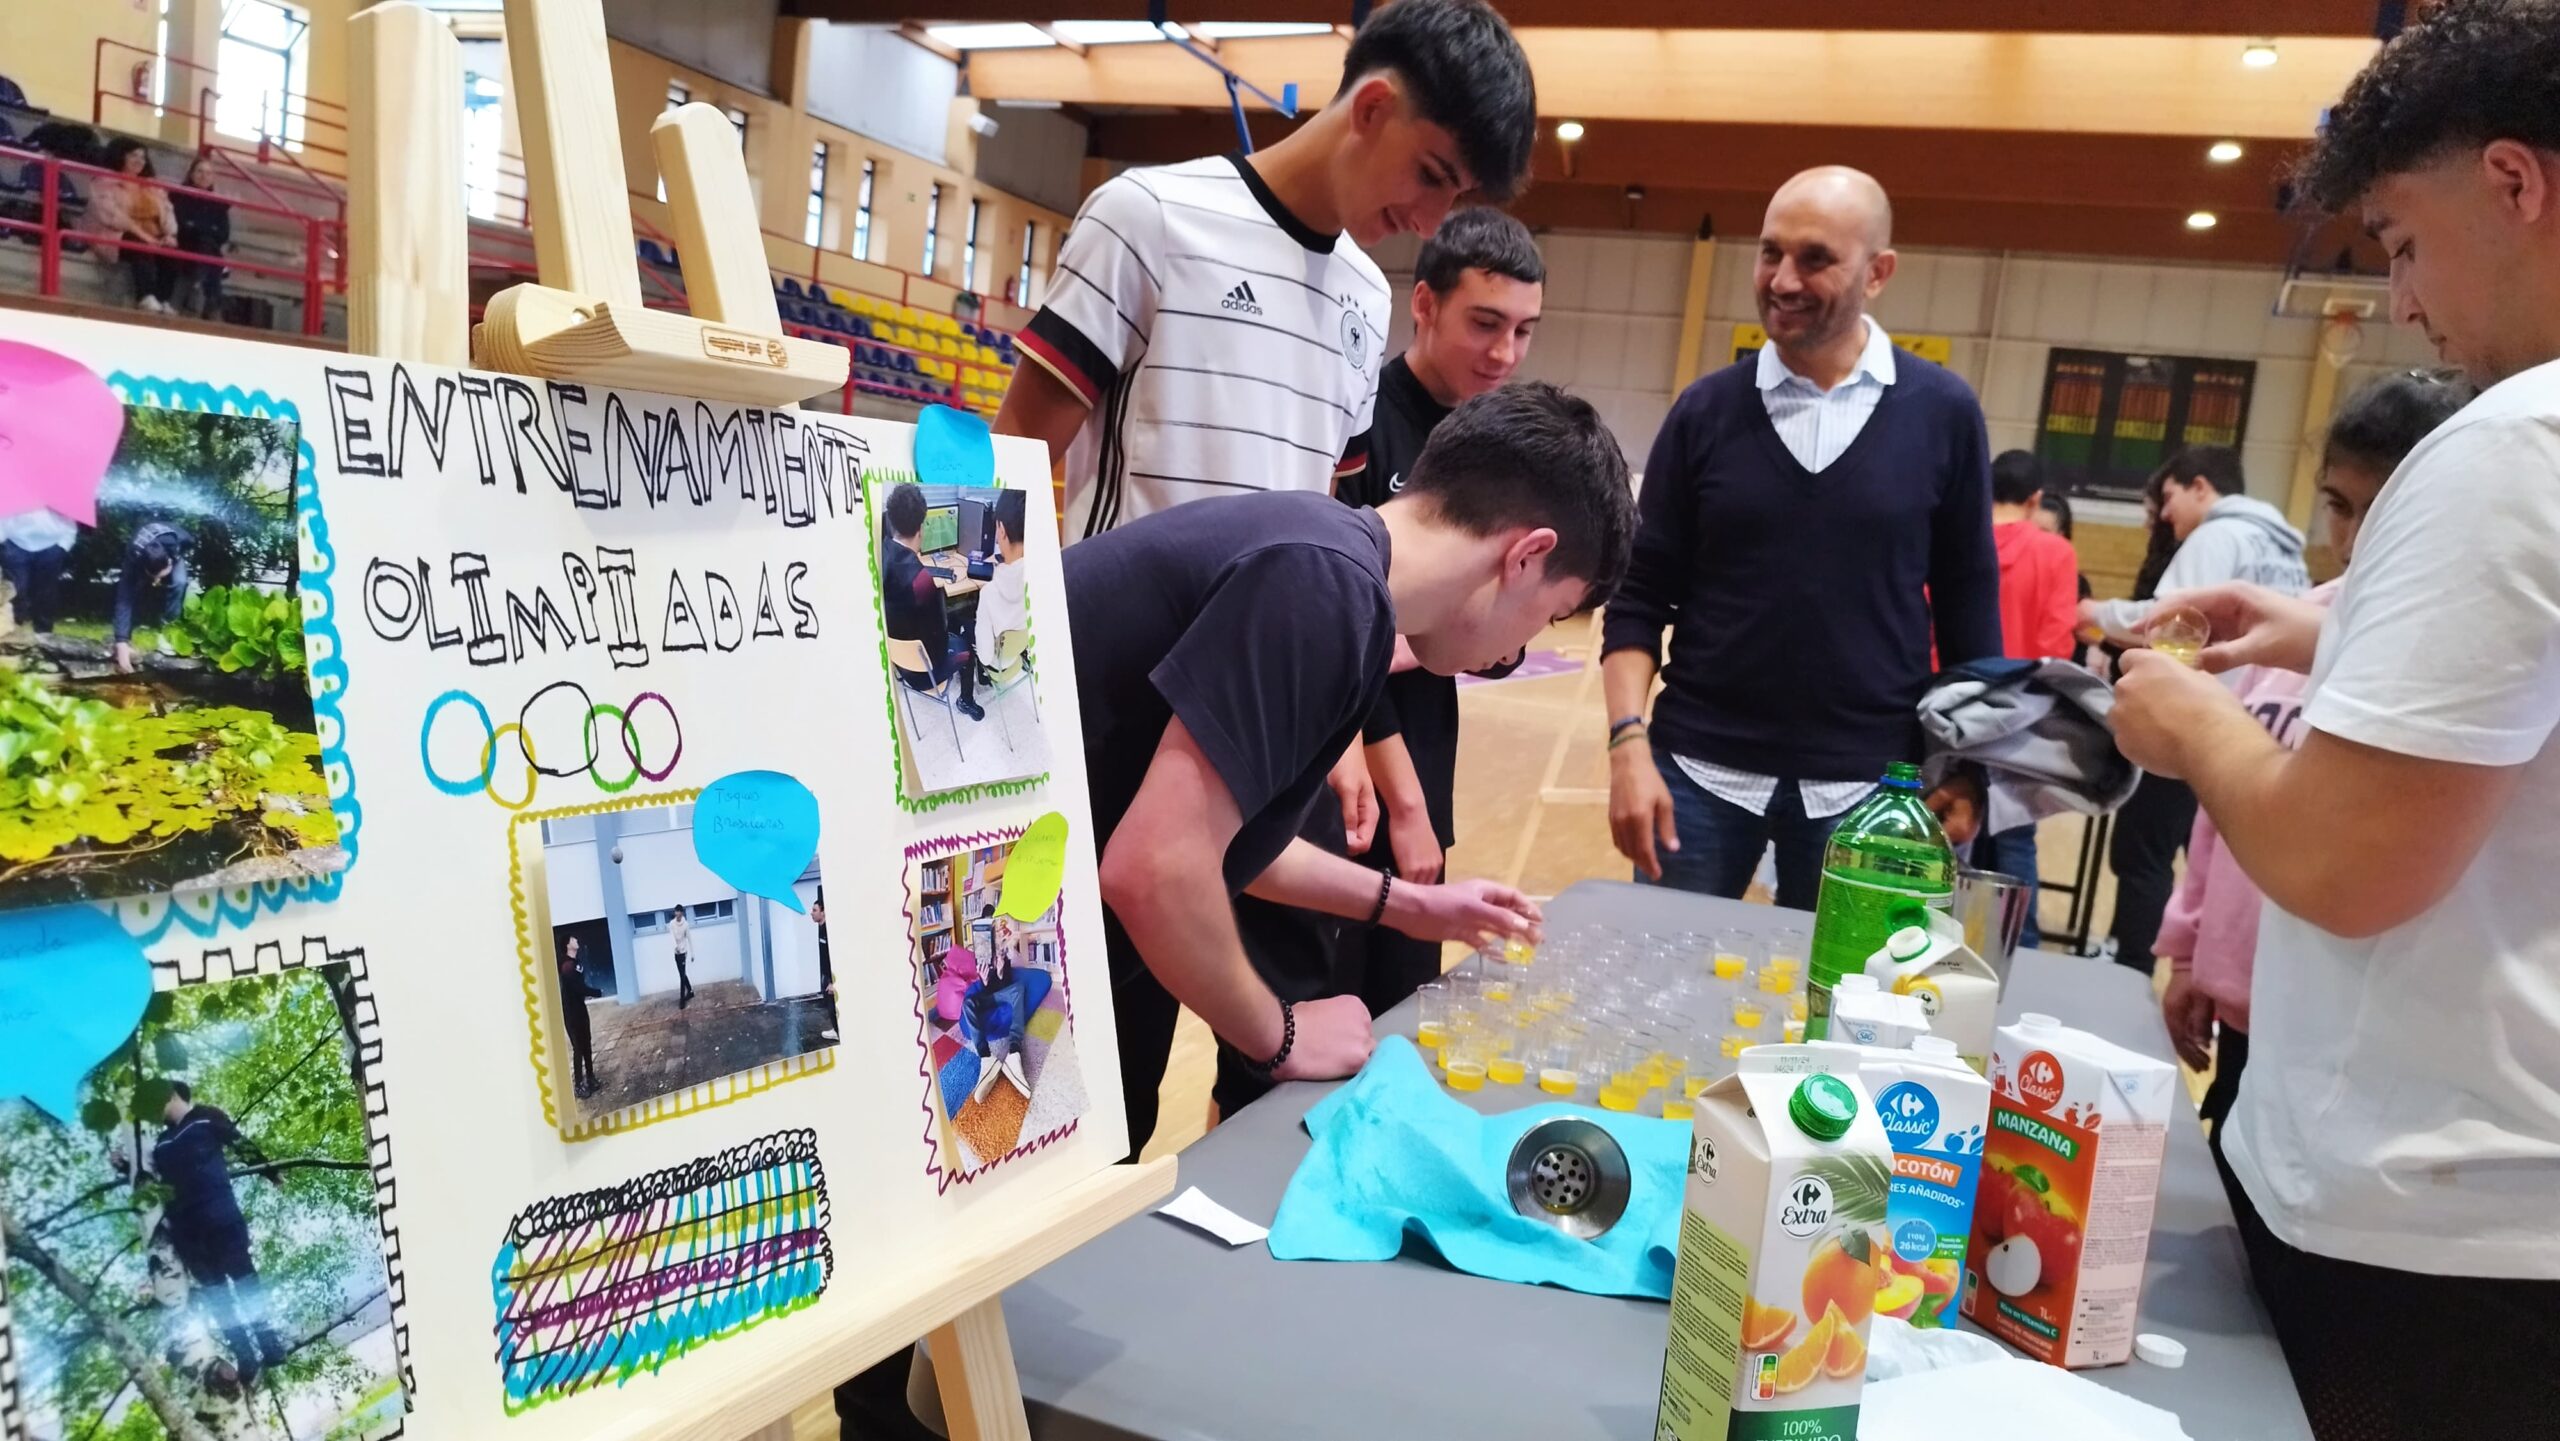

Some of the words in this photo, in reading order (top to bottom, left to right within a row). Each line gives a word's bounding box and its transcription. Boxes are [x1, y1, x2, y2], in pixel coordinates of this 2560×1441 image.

[1221, 298, 1263, 316] adidas
[363, 546, 820, 668] OLIMPIADAS
[2019, 1074, 2058, 1103] Classic
[1880, 1112, 1931, 1136] Classic
[1997, 1111, 2072, 1158] MANZANA
[1696, 1154, 1717, 1179] Extra
[1781, 1207, 1828, 1227] Extra
[1783, 1418, 1822, 1436] 100%
